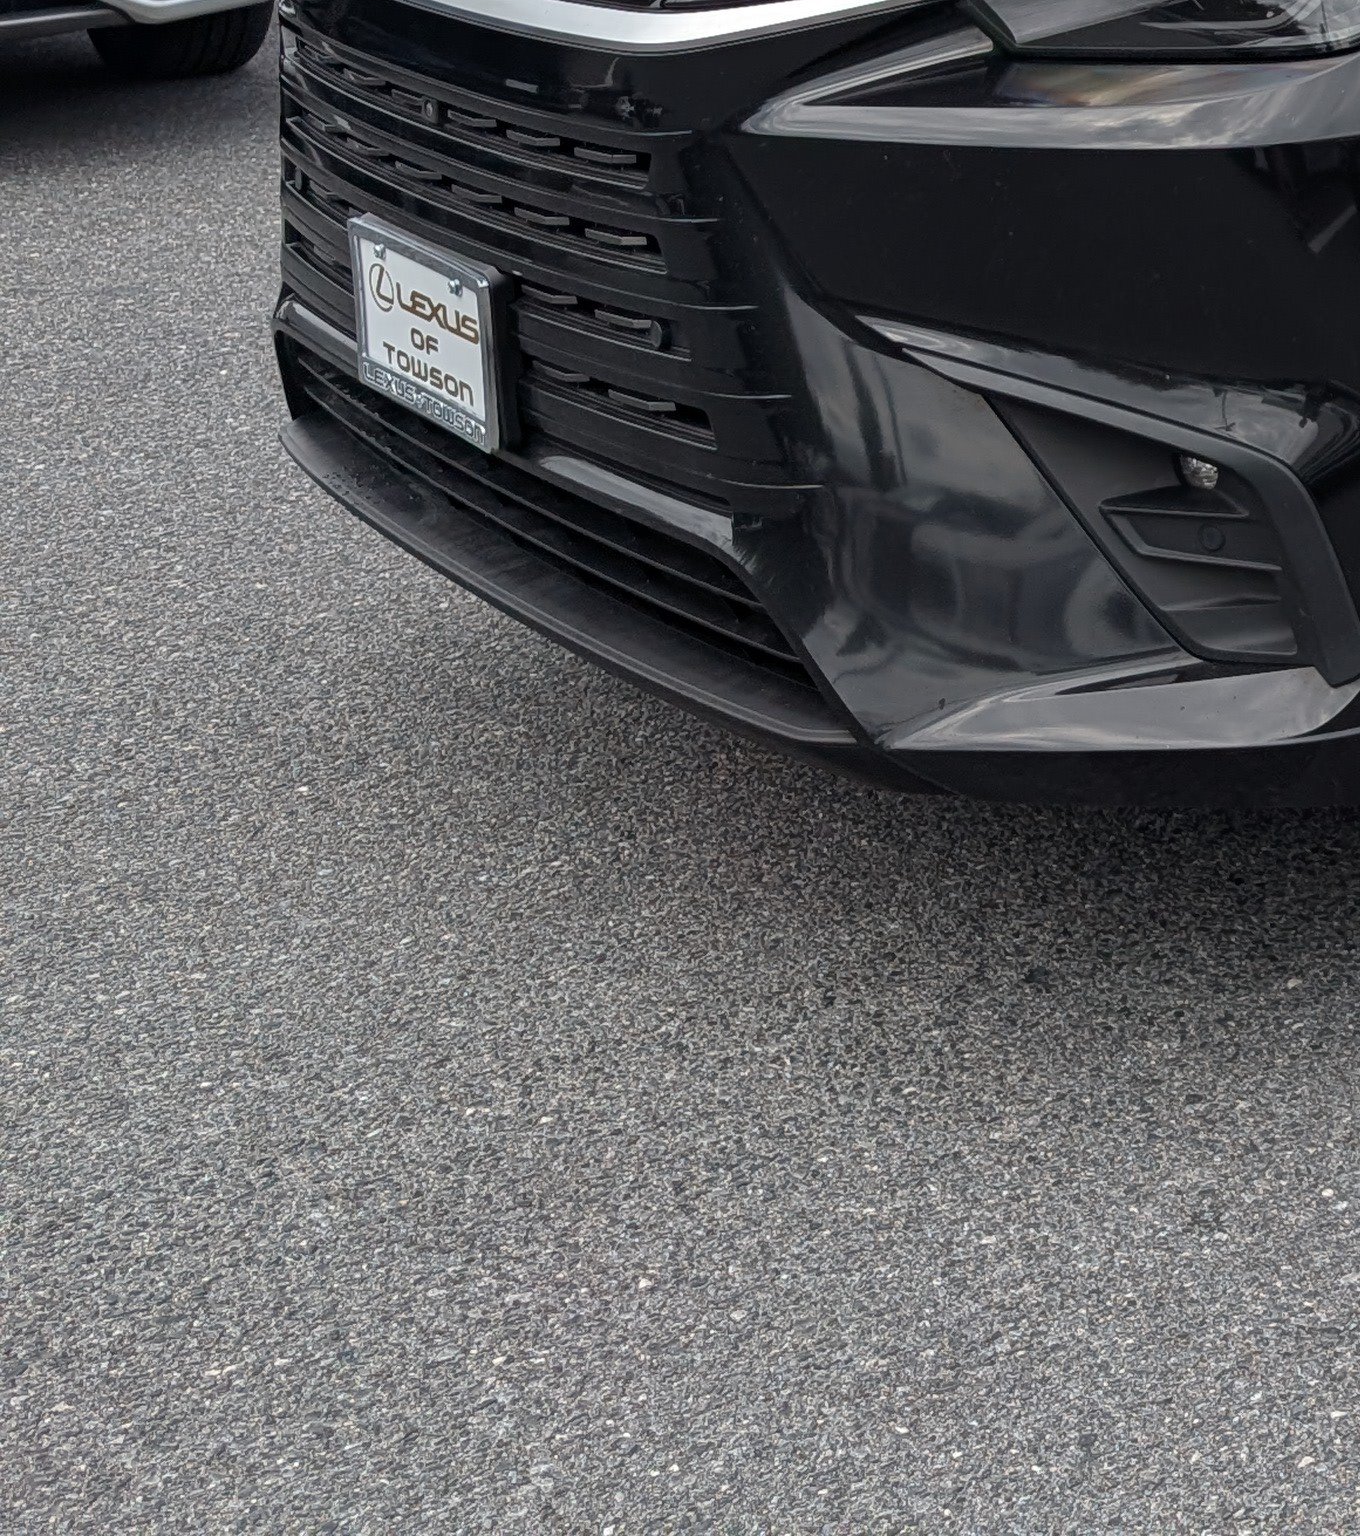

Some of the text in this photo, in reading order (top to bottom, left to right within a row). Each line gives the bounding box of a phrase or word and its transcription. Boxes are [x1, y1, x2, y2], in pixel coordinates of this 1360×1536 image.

[396, 281, 480, 345] LEXUS
[410, 327, 439, 356] OF
[362, 362, 418, 405] LEXUS
